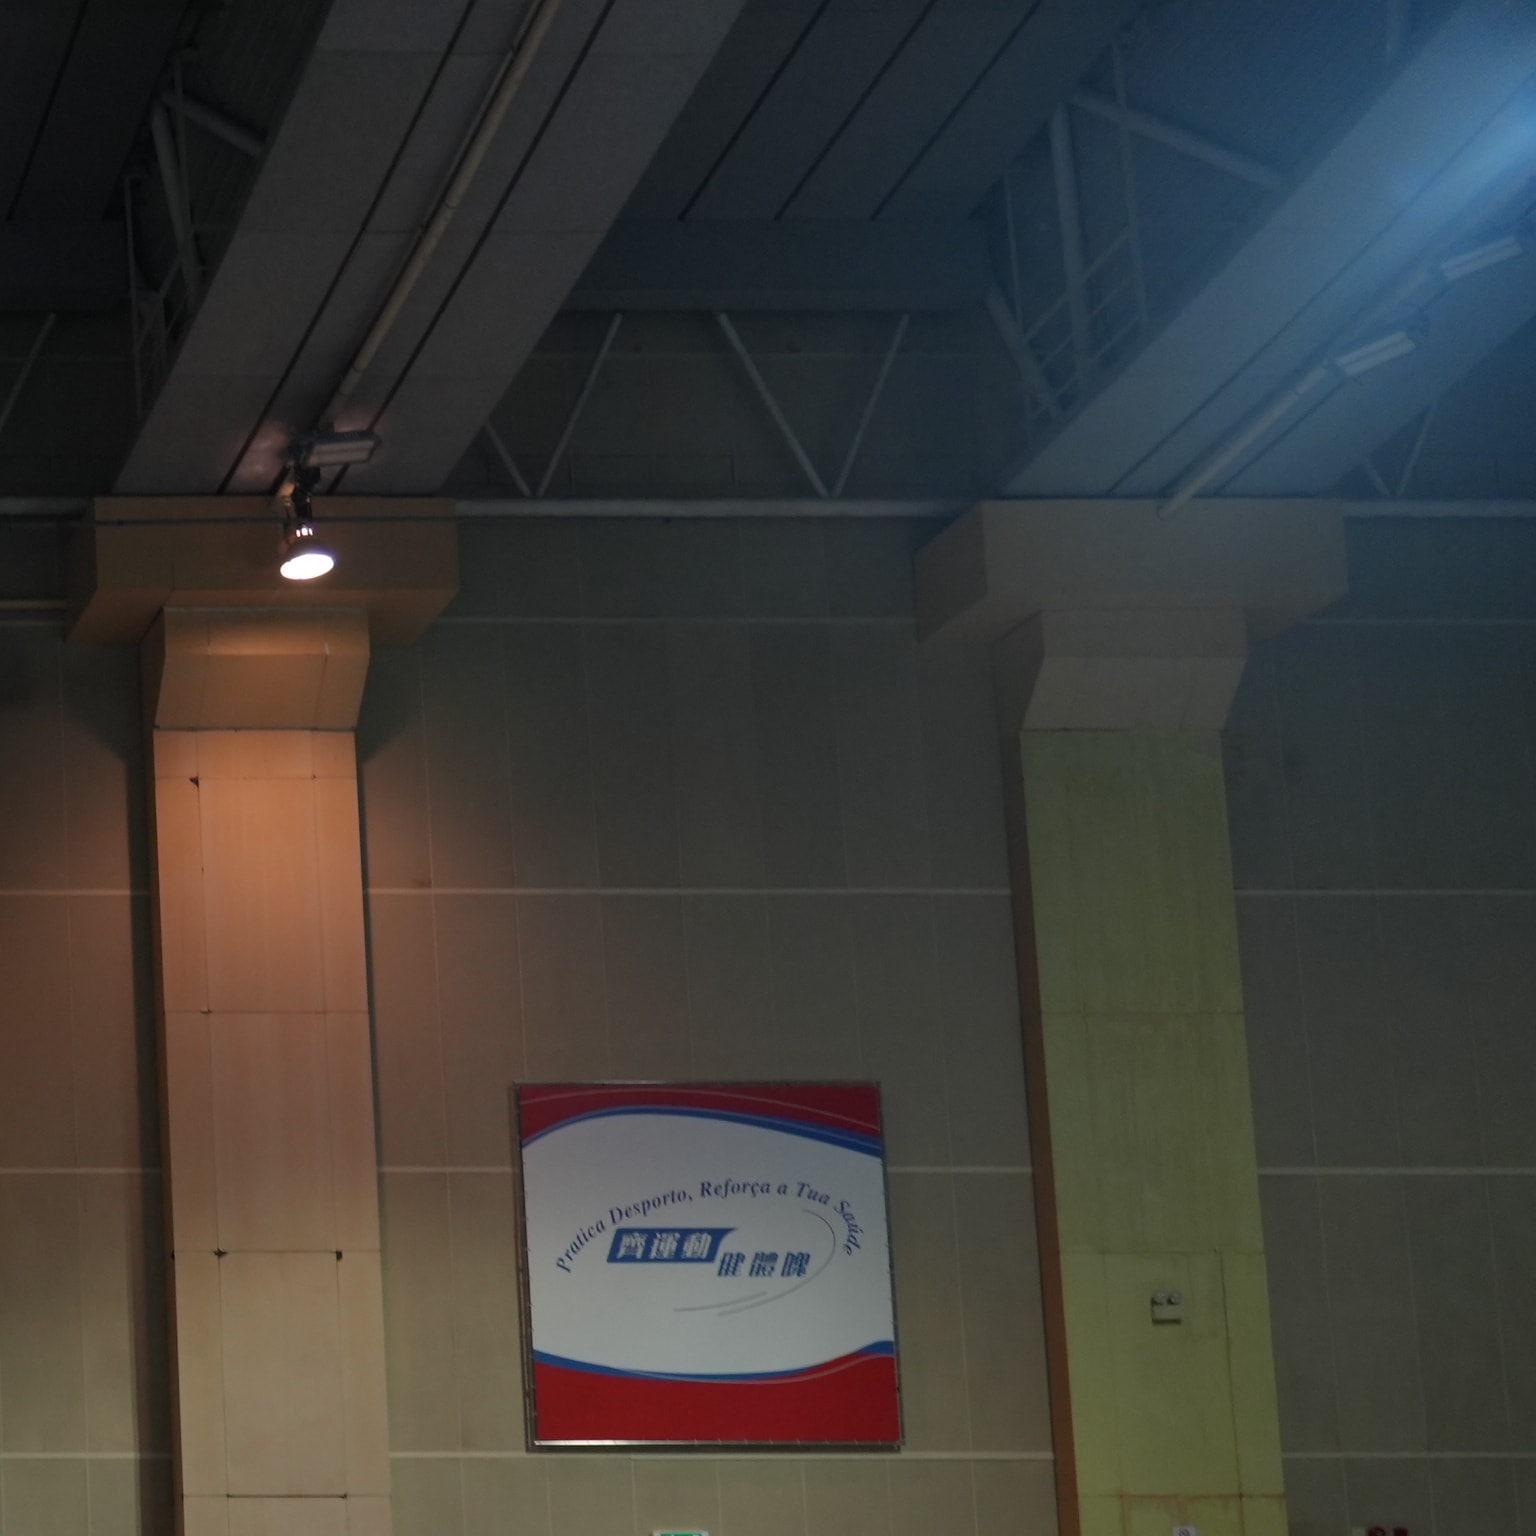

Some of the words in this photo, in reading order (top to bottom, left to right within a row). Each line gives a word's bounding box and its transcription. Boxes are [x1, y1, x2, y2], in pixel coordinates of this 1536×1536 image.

[555, 1220, 606, 1274] Pratica
[608, 1188, 694, 1225] Desporto,
[700, 1178, 771, 1199] Reforça
[777, 1184, 788, 1196] a
[796, 1181, 830, 1205] Tua
[834, 1199, 865, 1257] Saúde
[616, 1231, 712, 1260] 齊運動
